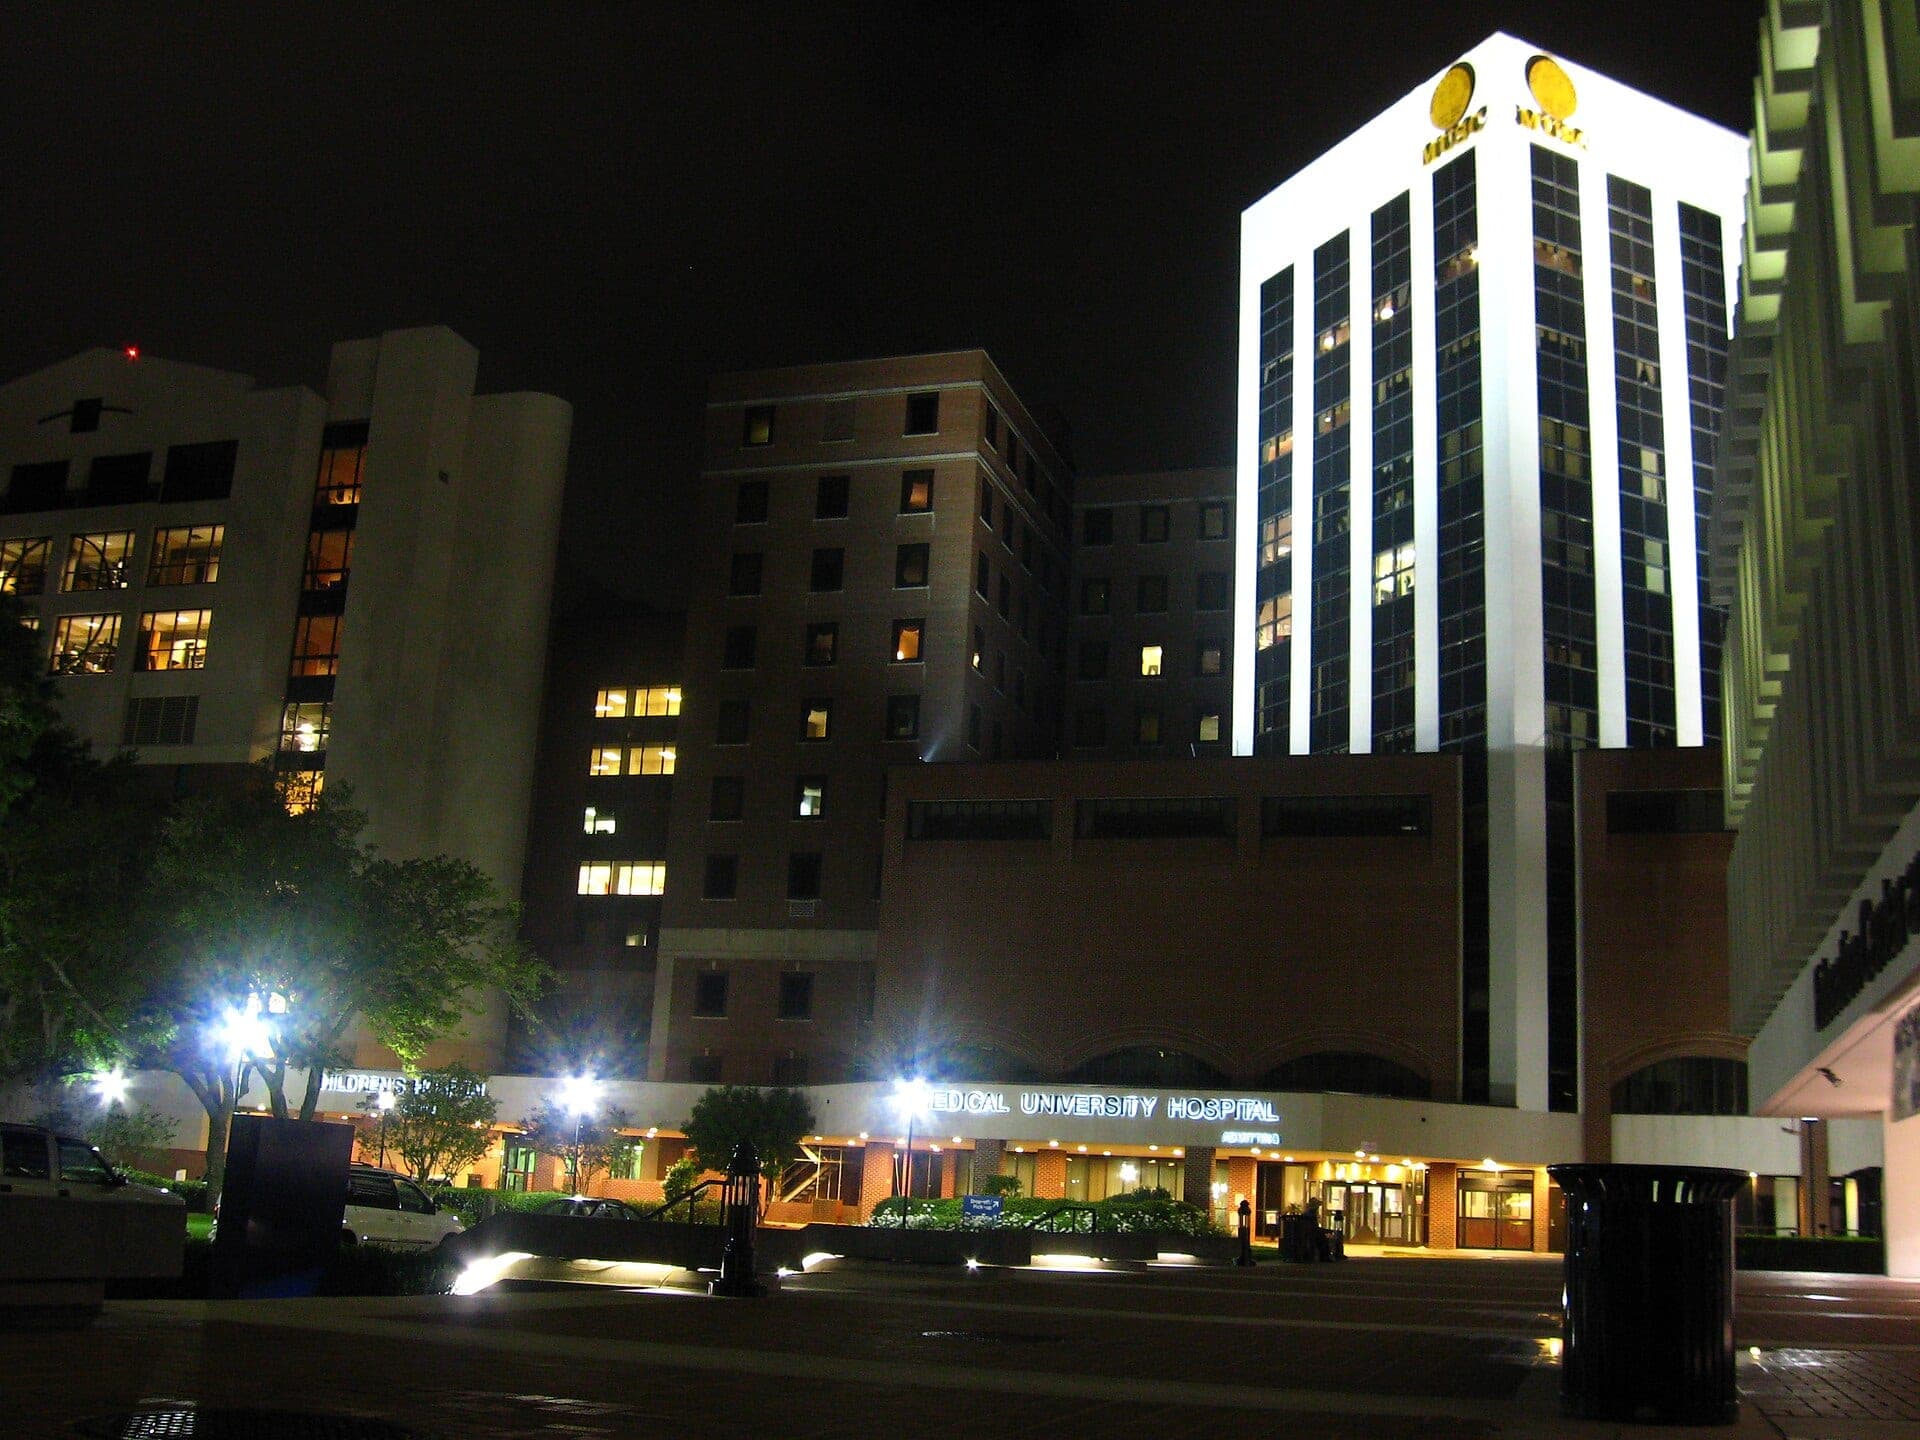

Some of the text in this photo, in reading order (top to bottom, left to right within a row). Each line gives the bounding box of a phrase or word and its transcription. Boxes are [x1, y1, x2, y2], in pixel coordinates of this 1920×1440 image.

[926, 1089, 1280, 1122] EDICAL UNIVERSITY HOSPITAL
